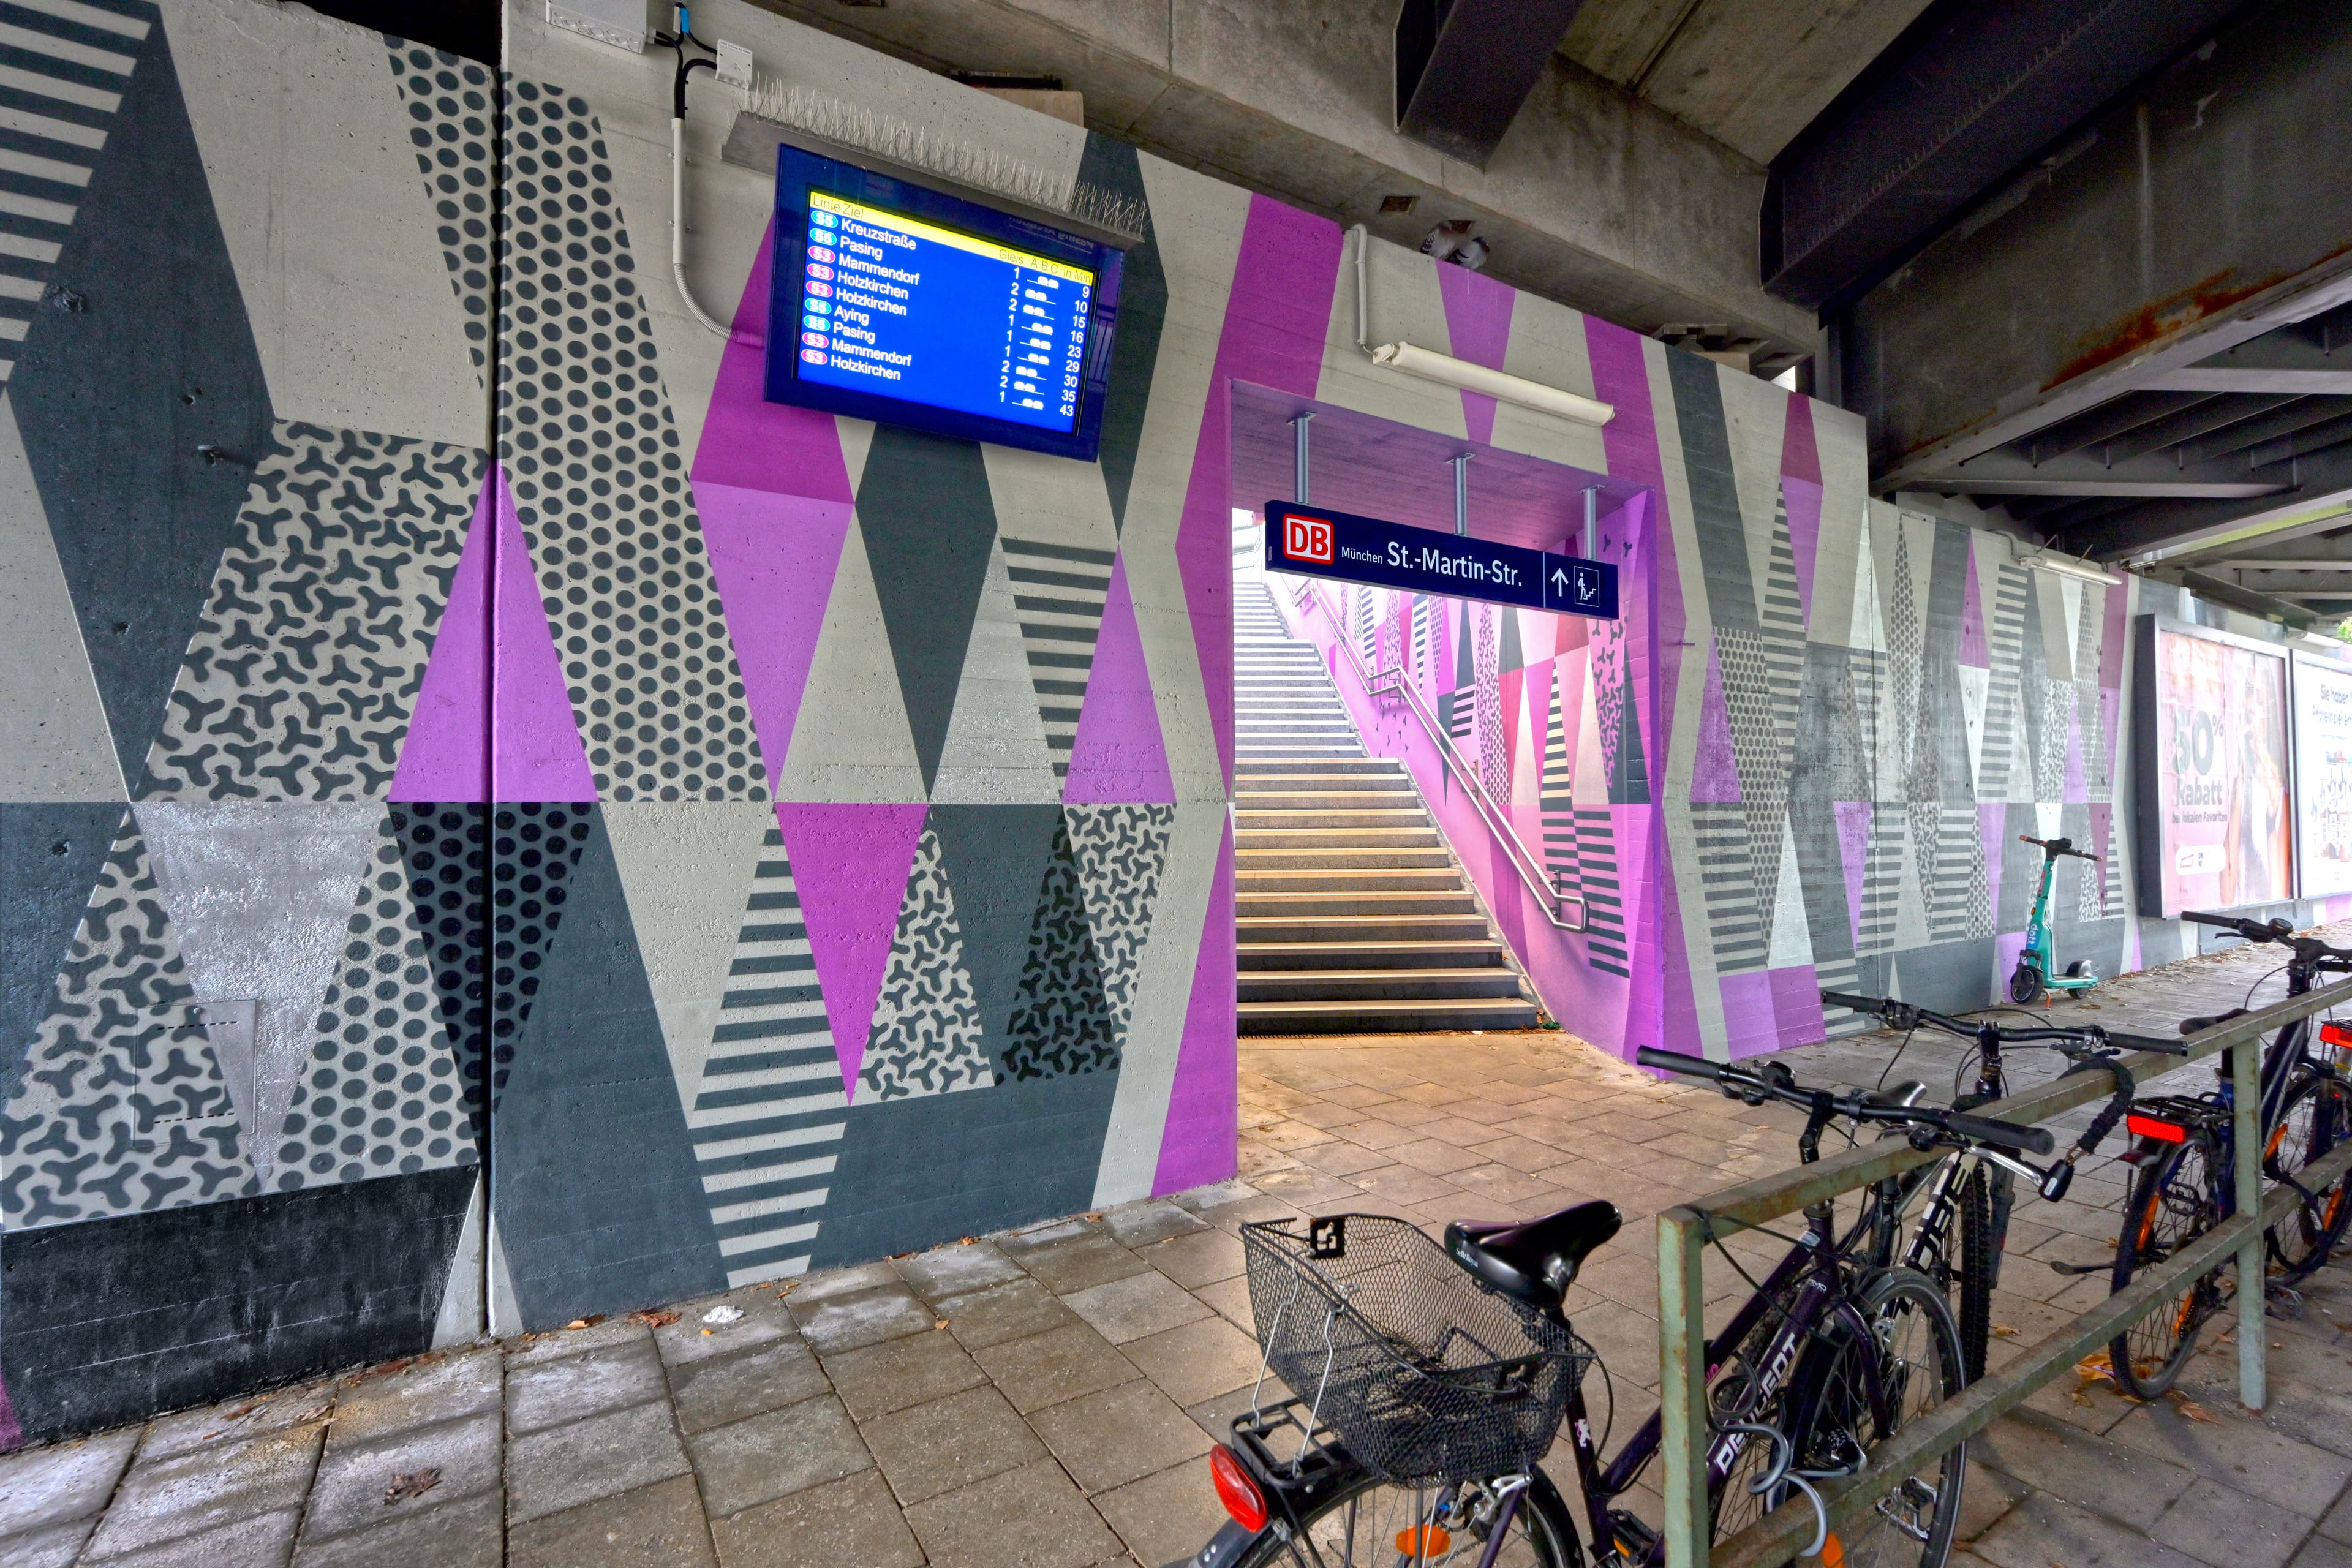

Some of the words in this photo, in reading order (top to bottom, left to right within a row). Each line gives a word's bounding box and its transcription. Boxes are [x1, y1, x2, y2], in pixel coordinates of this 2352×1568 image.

[813, 194, 841, 211] Linie
[842, 203, 864, 219] Ziel
[999, 249, 1024, 265] Gleis
[1030, 258, 1038, 269] A
[1041, 261, 1048, 271] B
[1050, 264, 1058, 274] C
[1063, 266, 1072, 277] in
[1074, 270, 1091, 284] Min
[815, 230, 832, 244] S5
[840, 235, 883, 262] Pasing
[1010, 282, 1019, 296] 2
[1074, 300, 1088, 314] 10
[816, 212, 834, 227] S5
[841, 218, 917, 251] Kreuzstraße
[1014, 266, 1020, 280] 1
[1082, 286, 1090, 298] 9
[810, 282, 829, 296] S3
[836, 287, 907, 316] Holzkirchen
[1006, 330, 1012, 342] 1
[1067, 344, 1082, 358] 23
[812, 265, 830, 279] S3
[837, 270, 909, 300] Holzkirchen
[1008, 314, 1014, 327] 1
[1071, 330, 1084, 344] 16
[813, 247, 831, 262] S3
[839, 252, 920, 285] Mammendorf
[1008, 298, 1017, 312] 2
[1072, 315, 1086, 328] 15
[807, 333, 824, 347] S3
[832, 338, 912, 367] Mammendorf
[1000, 375, 1008, 388] 2
[1061, 389, 1076, 402] 35
[809, 316, 826, 330] S5
[833, 321, 876, 345] Pasing
[1001, 360, 1010, 373] 2
[1063, 374, 1077, 388] 30
[810, 299, 827, 314] S5
[834, 304, 870, 326] Aying
[1005, 345, 1011, 358] 1
[1065, 360, 1080, 373] 29
[805, 350, 823, 364] S3
[831, 354, 901, 381] Holzkirchen
[999, 391, 1005, 403] 1
[1059, 404, 1074, 417] 43
[1289, 521, 1329, 556] DB
[1341, 546, 1384, 564] München
[1387, 541, 1523, 587] St.-Martin-Str.
[2176, 776, 2223, 806] Rabatt
[2182, 810, 2203, 823] lokalen
[2203, 810, 2228, 823] Favoriten
[2027, 924, 2039, 945] dott
